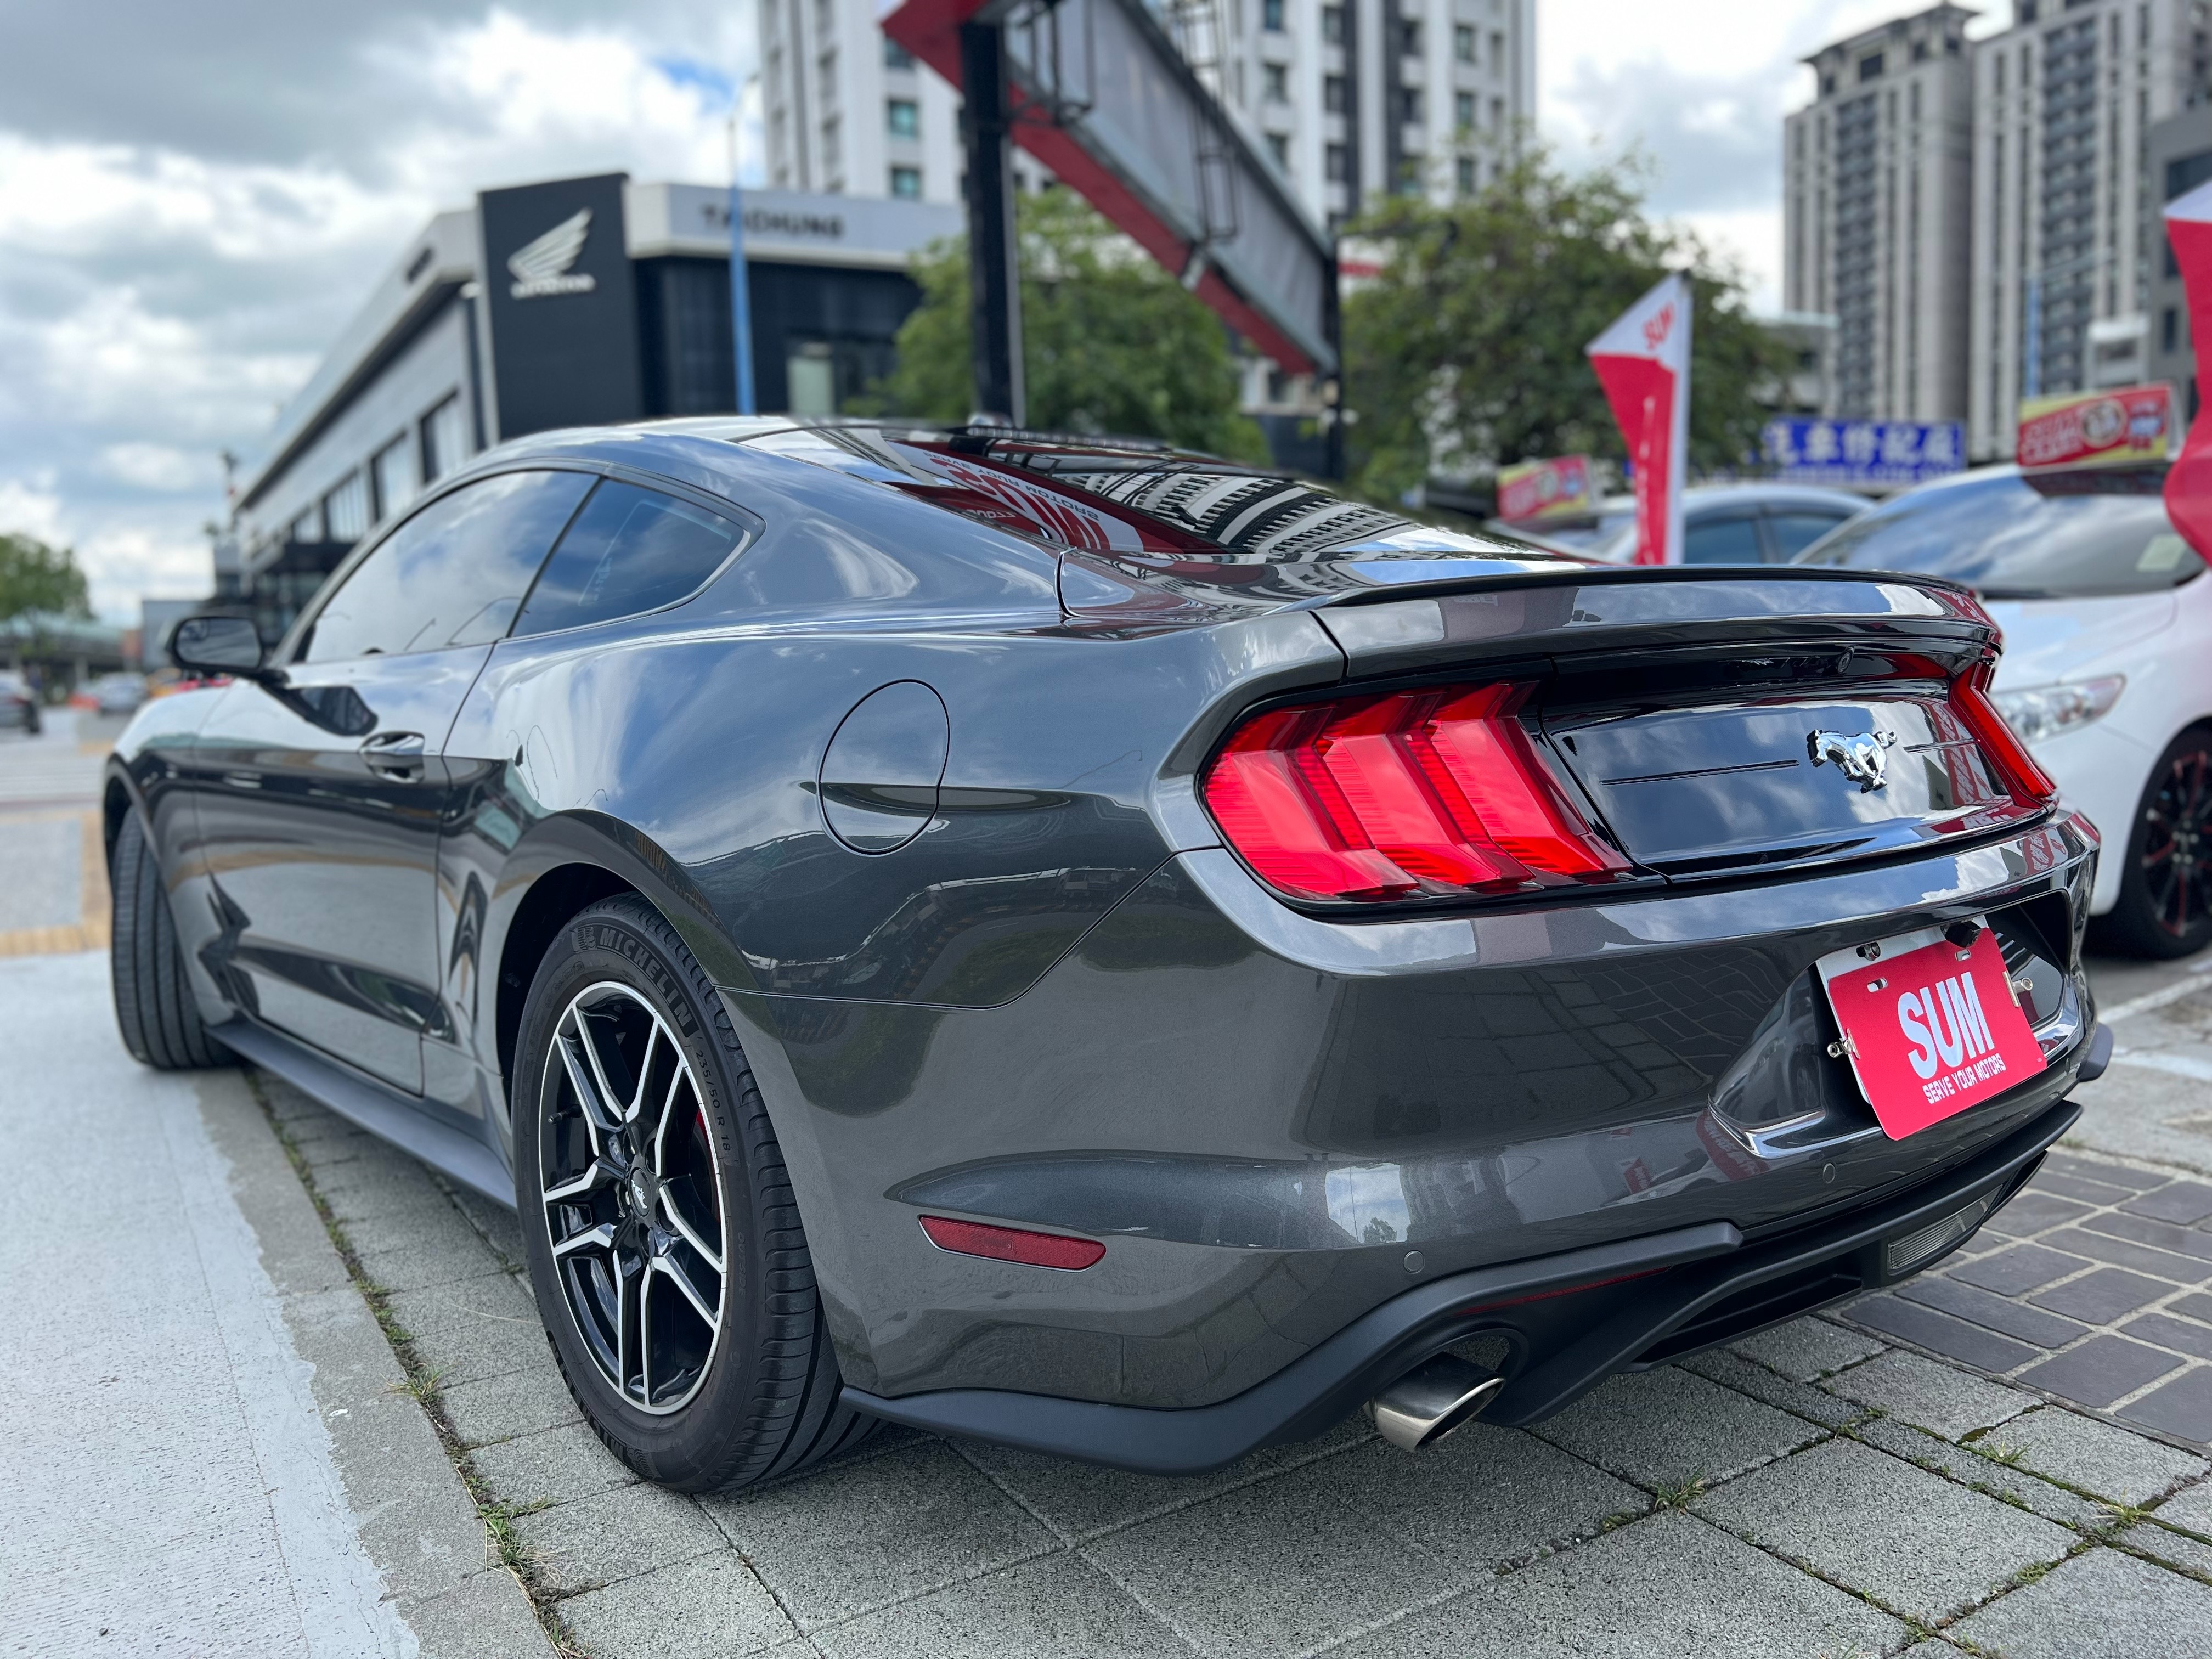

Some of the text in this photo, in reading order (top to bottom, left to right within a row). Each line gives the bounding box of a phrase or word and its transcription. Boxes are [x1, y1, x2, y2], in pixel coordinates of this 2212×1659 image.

[600, 928, 692, 1027] MICHELIN
[1897, 972, 1995, 1079] SUM
[696, 1051, 720, 1108] 235/50
[1922, 1053, 2006, 1104] SERVE YOUR MOTORS
